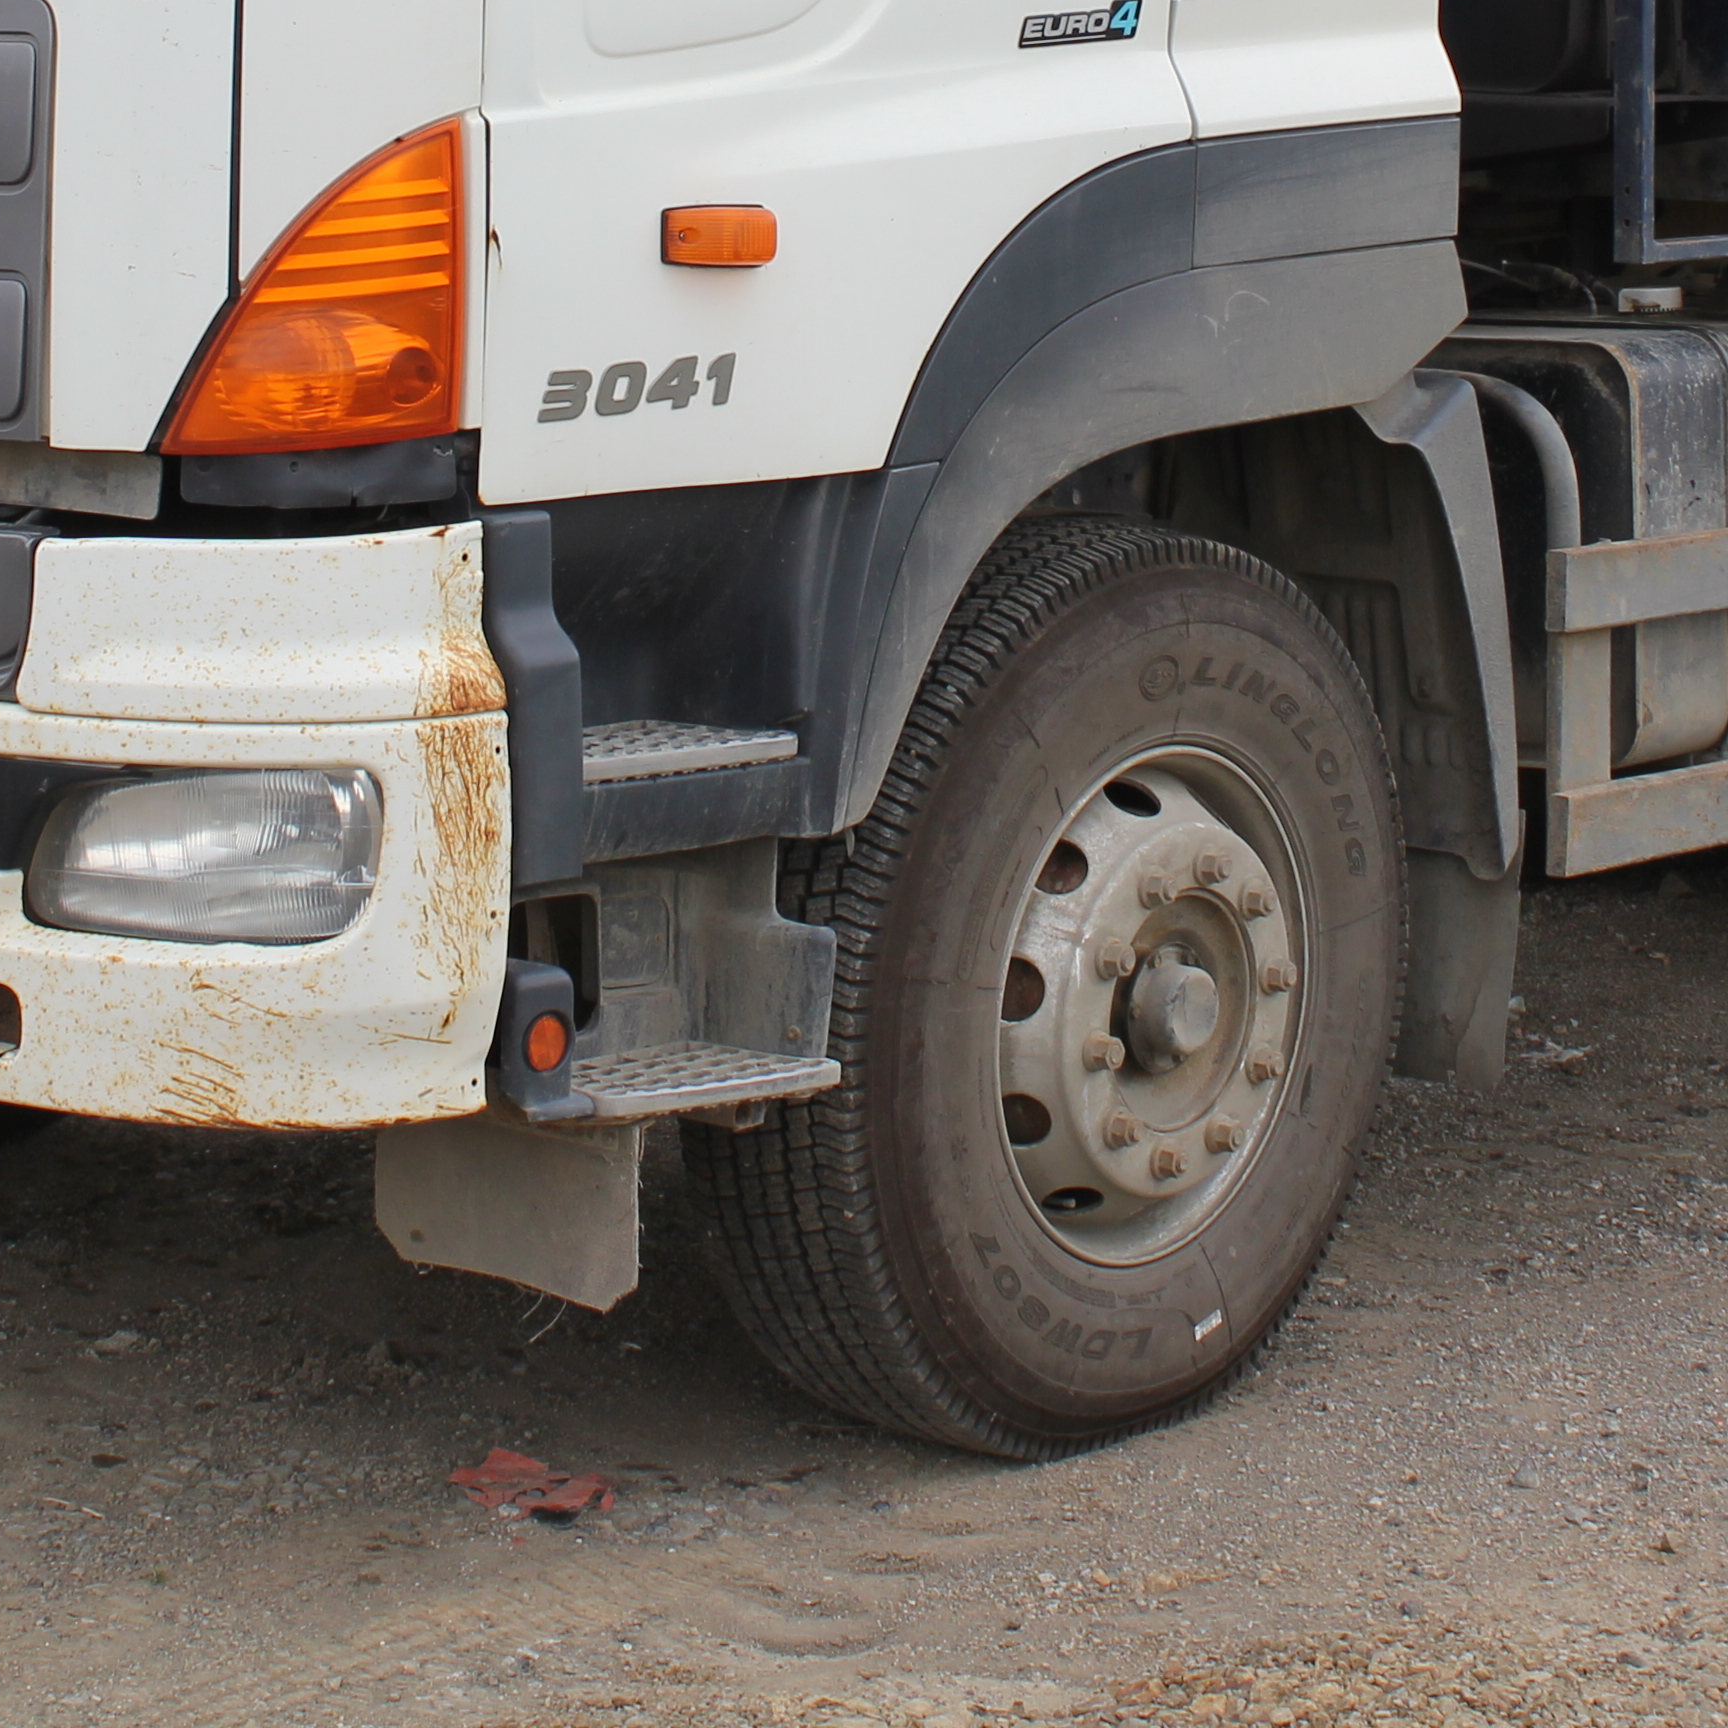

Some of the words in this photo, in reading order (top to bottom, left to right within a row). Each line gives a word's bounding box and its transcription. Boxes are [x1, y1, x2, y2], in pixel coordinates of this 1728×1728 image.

[537, 352, 737, 423] 3041
[1190, 656, 1367, 877] LINGLONG
[969, 1231, 1153, 1360] LDW807
